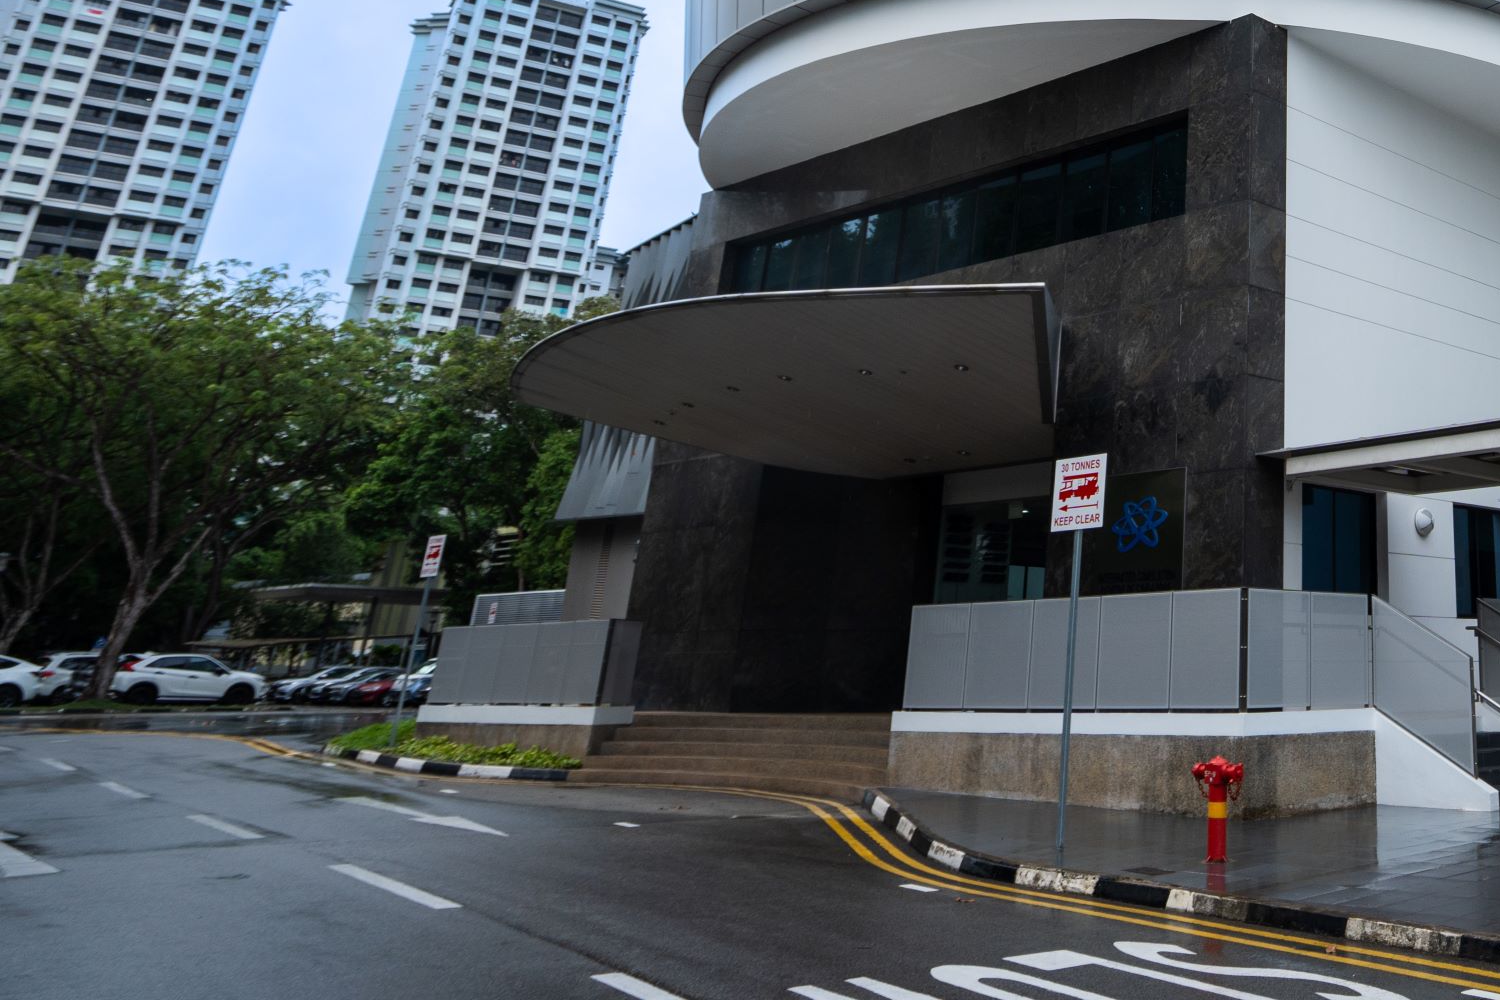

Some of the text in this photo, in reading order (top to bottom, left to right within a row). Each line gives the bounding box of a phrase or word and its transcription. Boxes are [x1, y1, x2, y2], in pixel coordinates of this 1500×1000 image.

[1061, 459, 1101, 473] 30 TONNES
[1054, 513, 1100, 526] KEEP CLEAR
